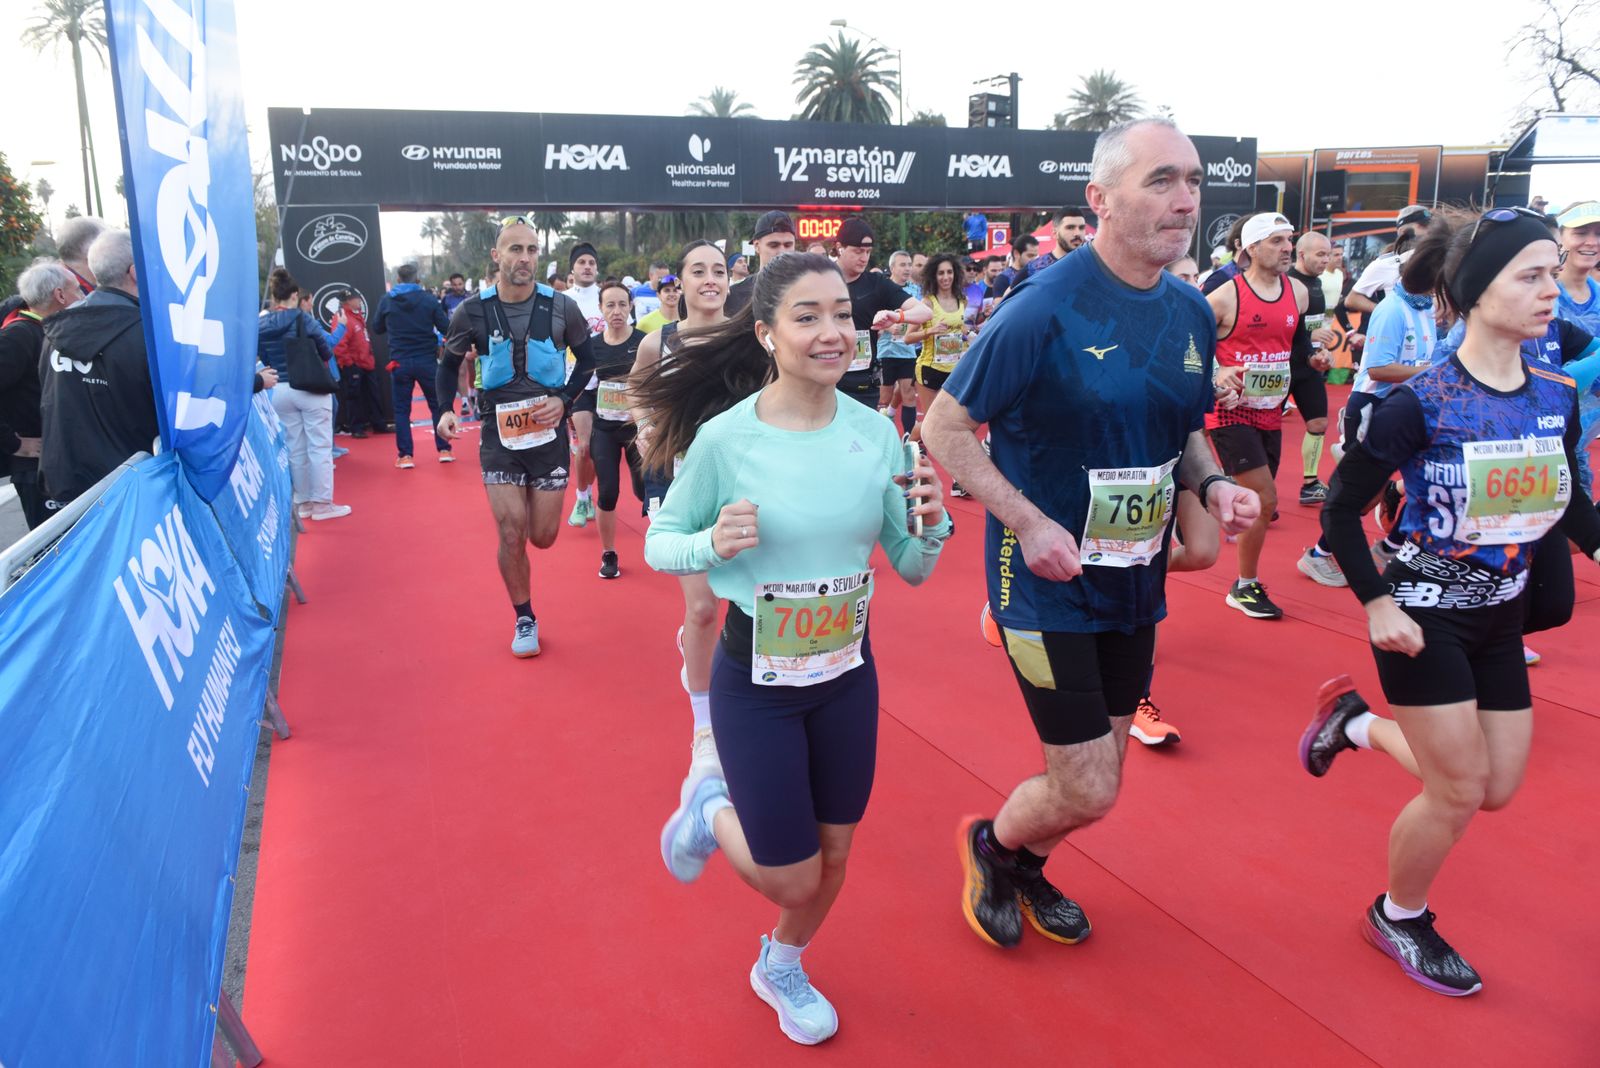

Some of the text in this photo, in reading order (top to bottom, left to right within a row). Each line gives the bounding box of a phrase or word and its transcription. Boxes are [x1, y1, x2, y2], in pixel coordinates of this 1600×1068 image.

[432, 147, 502, 159] HYUNDAI
[544, 143, 628, 170] HOKA
[802, 145, 895, 166] maratón
[478, 161, 502, 170] Motor
[665, 163, 736, 178] quirónsalud
[826, 162, 897, 184] sevilla
[948, 153, 1012, 178] HOKA
[672, 179, 730, 188] Healthcare Partner
[814, 187, 880, 199] 28 enero 2024
[1251, 374, 1282, 389] 7059
[506, 412, 537, 429] 407
[1097, 470, 1147, 481] MEDIO MARATÓN
[1486, 464, 1549, 499] 6651
[763, 573, 861, 594] MEDIO MARATÓN SEVILLA
[113, 503, 216, 711] HOKA
[774, 602, 849, 639] 7024
[187, 615, 242, 788] FLY HUMAN FLY
